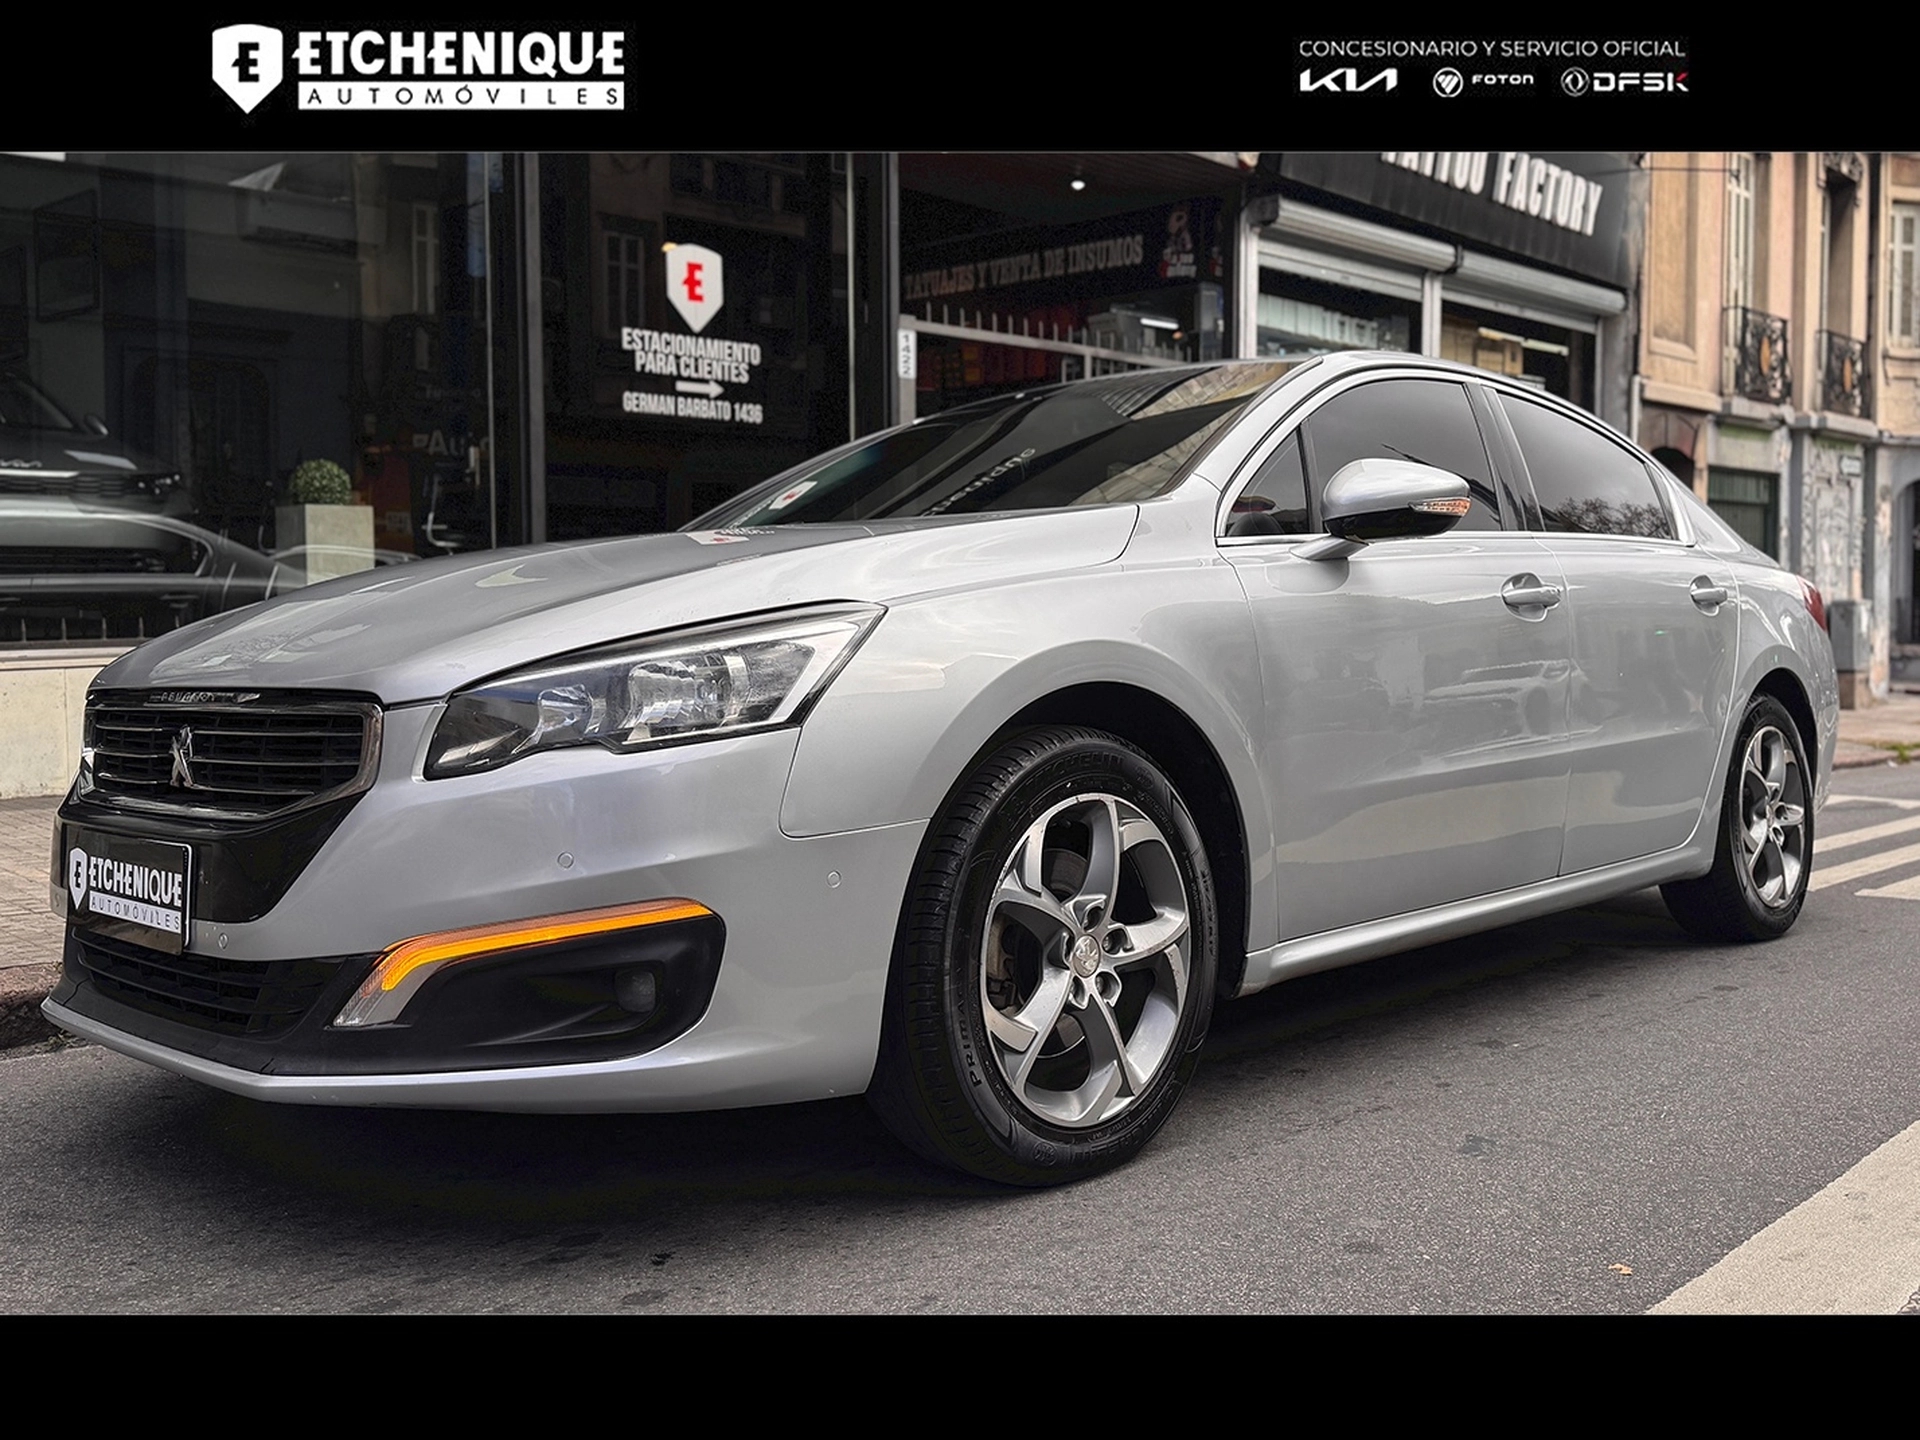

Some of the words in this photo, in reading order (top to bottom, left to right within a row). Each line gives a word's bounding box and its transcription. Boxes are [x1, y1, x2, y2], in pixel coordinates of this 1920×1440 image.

[1493, 152, 1603, 236] FACTORY
[977, 262, 990, 289] Y
[990, 252, 1042, 285] VENTA
[1043, 247, 1066, 277] DE
[1068, 234, 1144, 274] INSUMOS
[621, 326, 762, 366] ESTACIONAMIENTO
[635, 350, 678, 377] PARA
[679, 355, 750, 384] CLIENTES
[622, 391, 675, 416] GERMAN
[677, 396, 732, 421] BARBATO
[734, 402, 764, 424] 1436
[88, 856, 183, 907] ETCHENIQUE
[90, 895, 181, 930] AUTOMÓVILES
